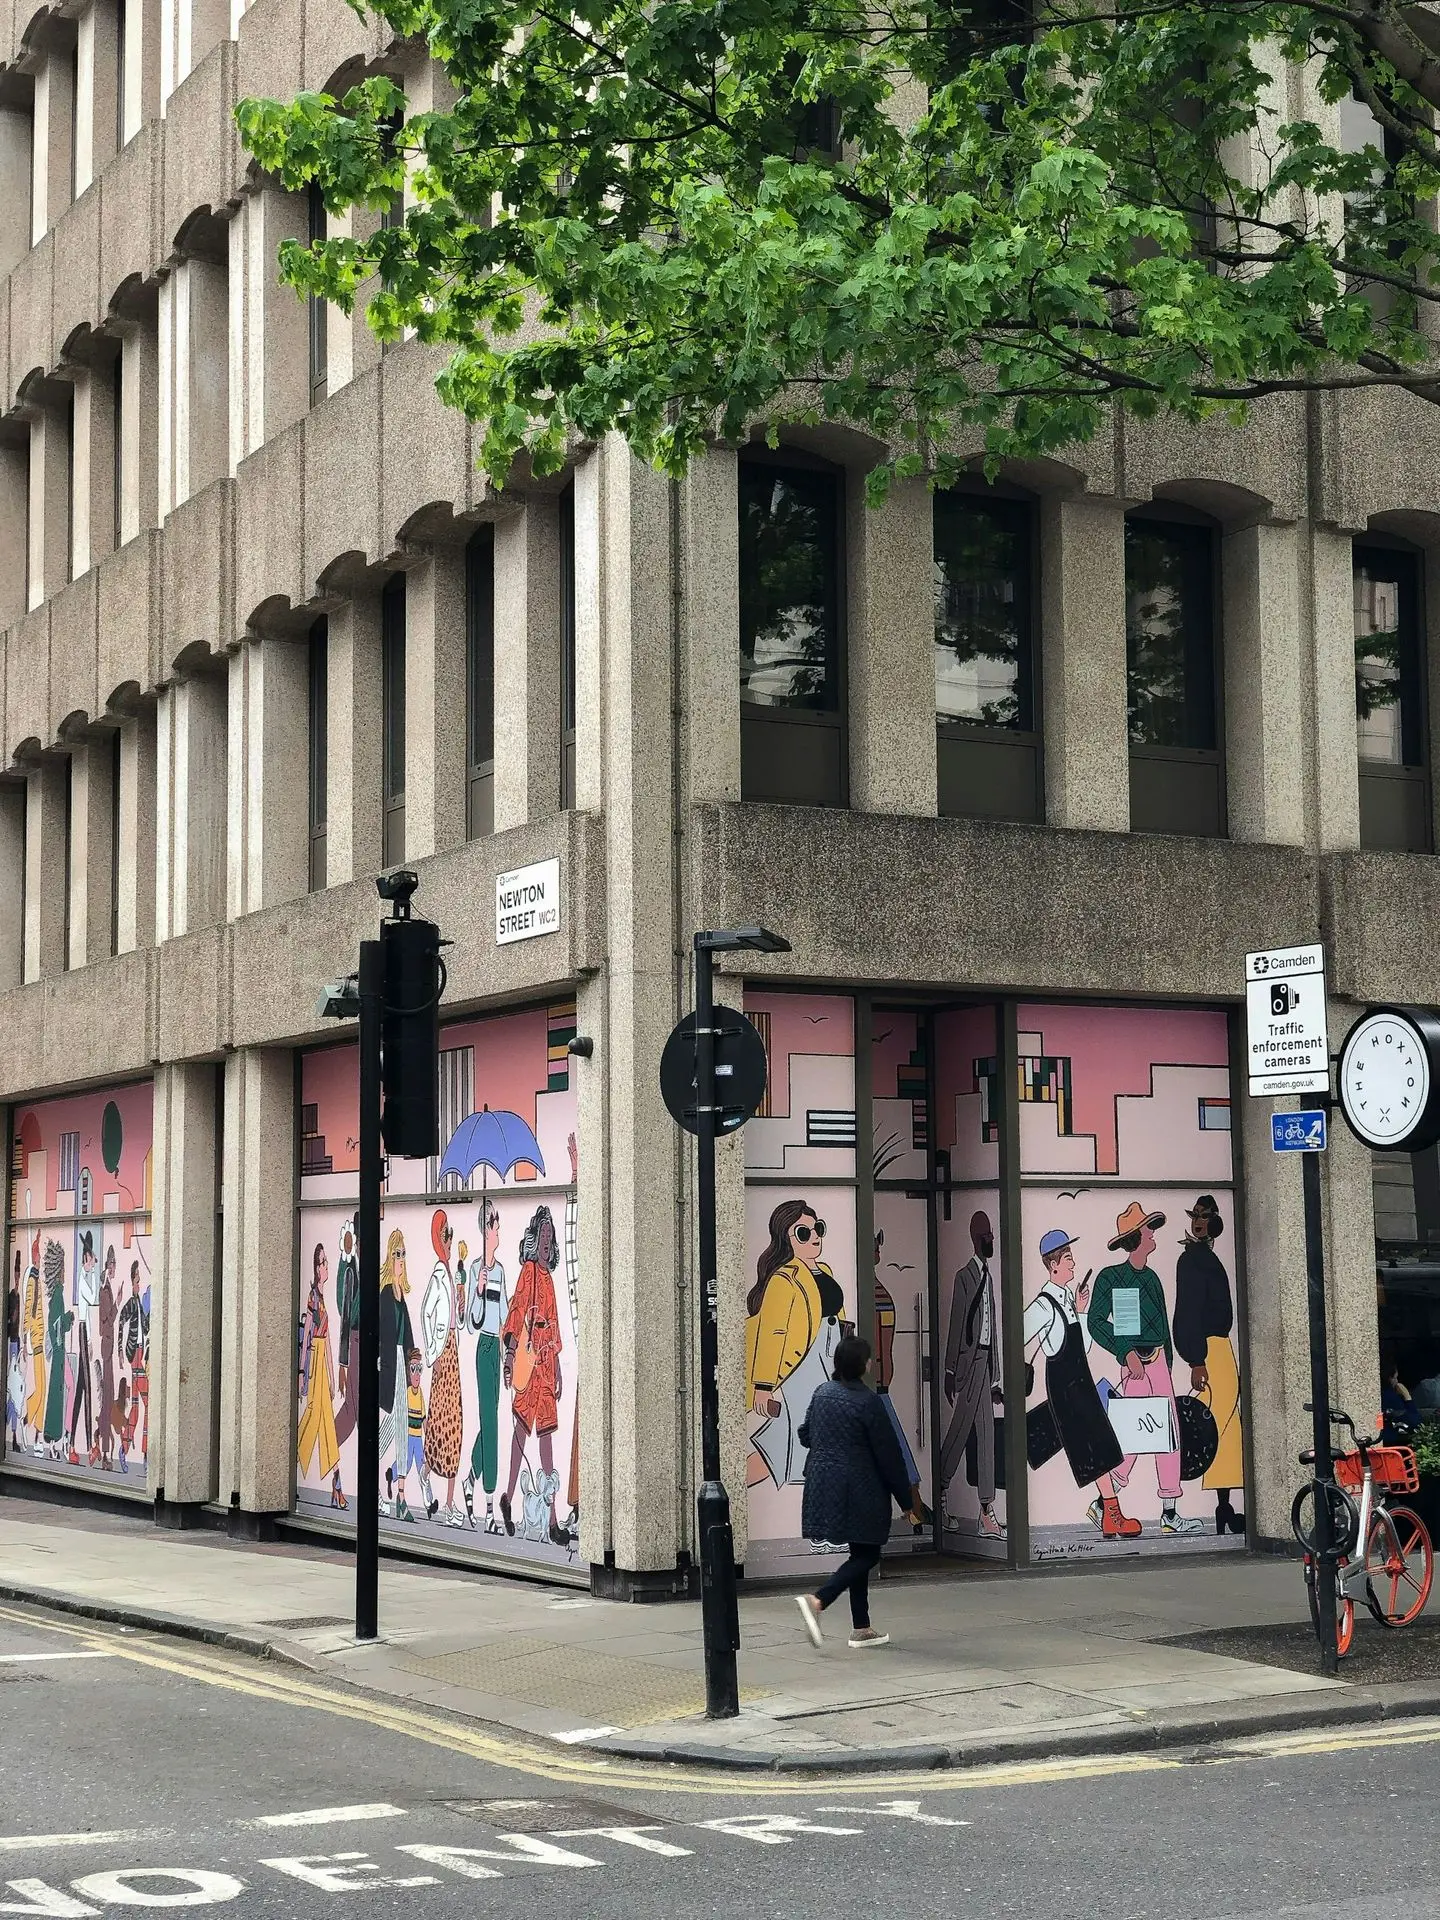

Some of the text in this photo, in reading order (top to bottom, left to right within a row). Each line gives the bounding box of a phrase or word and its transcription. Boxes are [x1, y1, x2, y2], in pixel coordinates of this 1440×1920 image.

[499, 882, 545, 911] NEWTON
[499, 908, 556, 935] STREET WC2
[1270, 954, 1316, 970] Camden
[1268, 1022, 1304, 1036] Traffic
[1252, 1036, 1323, 1053] enforcement
[1264, 1055, 1311, 1068] cameras
[1355, 1034, 1416, 1110] THE HOXTON
[1263, 1079, 1315, 1091] camden.gov.uk
[257, 1800, 974, 1893] ENTRY
